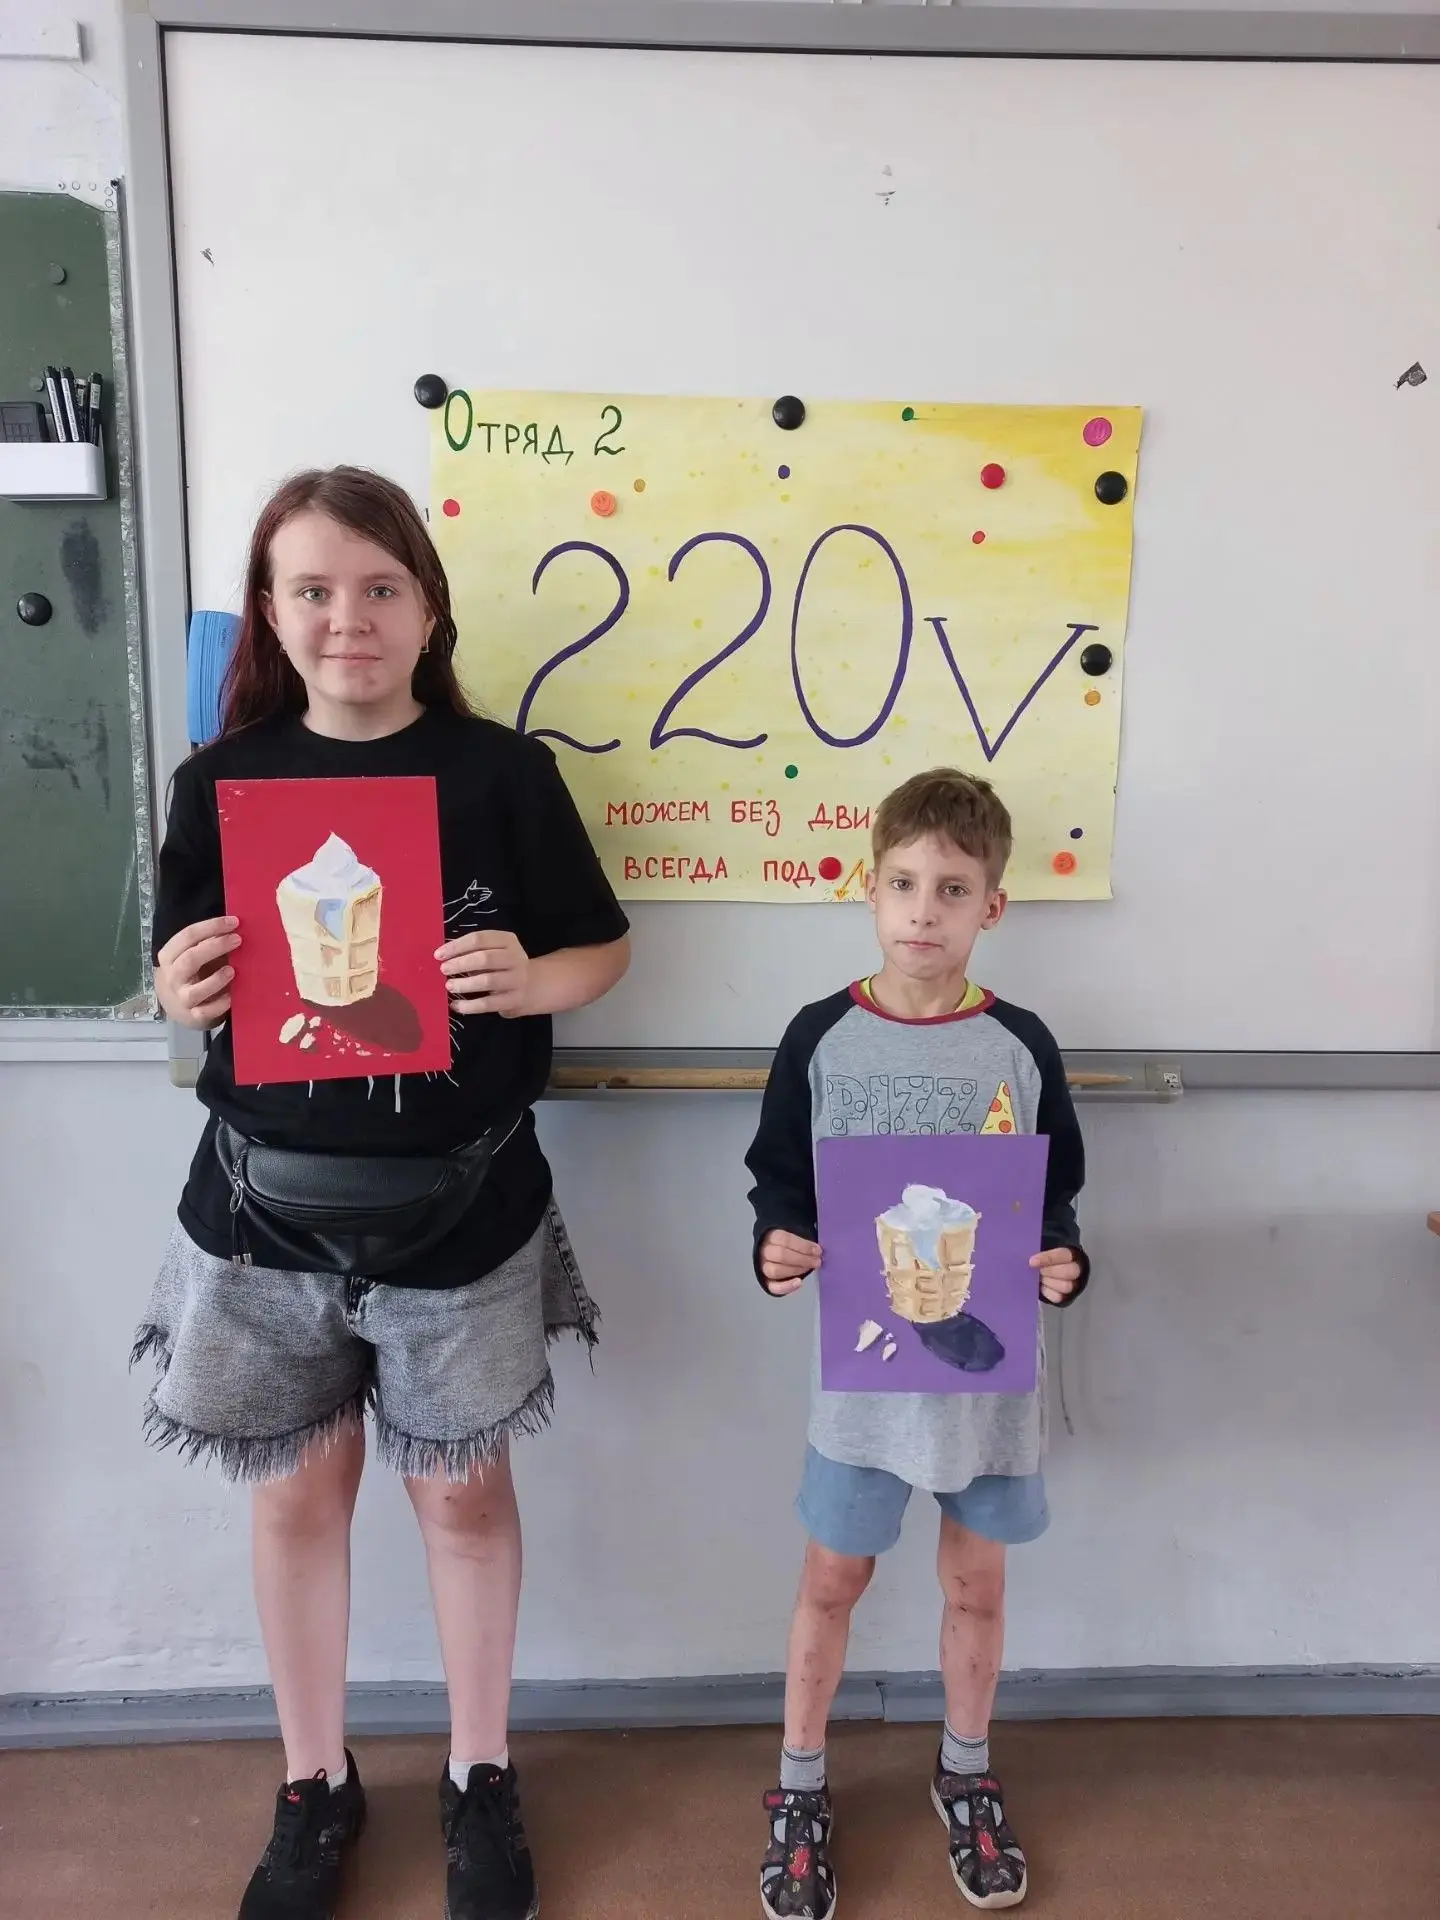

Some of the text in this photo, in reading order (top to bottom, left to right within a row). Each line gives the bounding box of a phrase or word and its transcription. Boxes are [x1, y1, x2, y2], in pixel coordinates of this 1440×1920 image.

[594, 405, 626, 456] 2
[605, 800, 879, 836] МОЖЕМ БЕЗ ДВИ
[624, 856, 728, 884] ВСЕГДА
